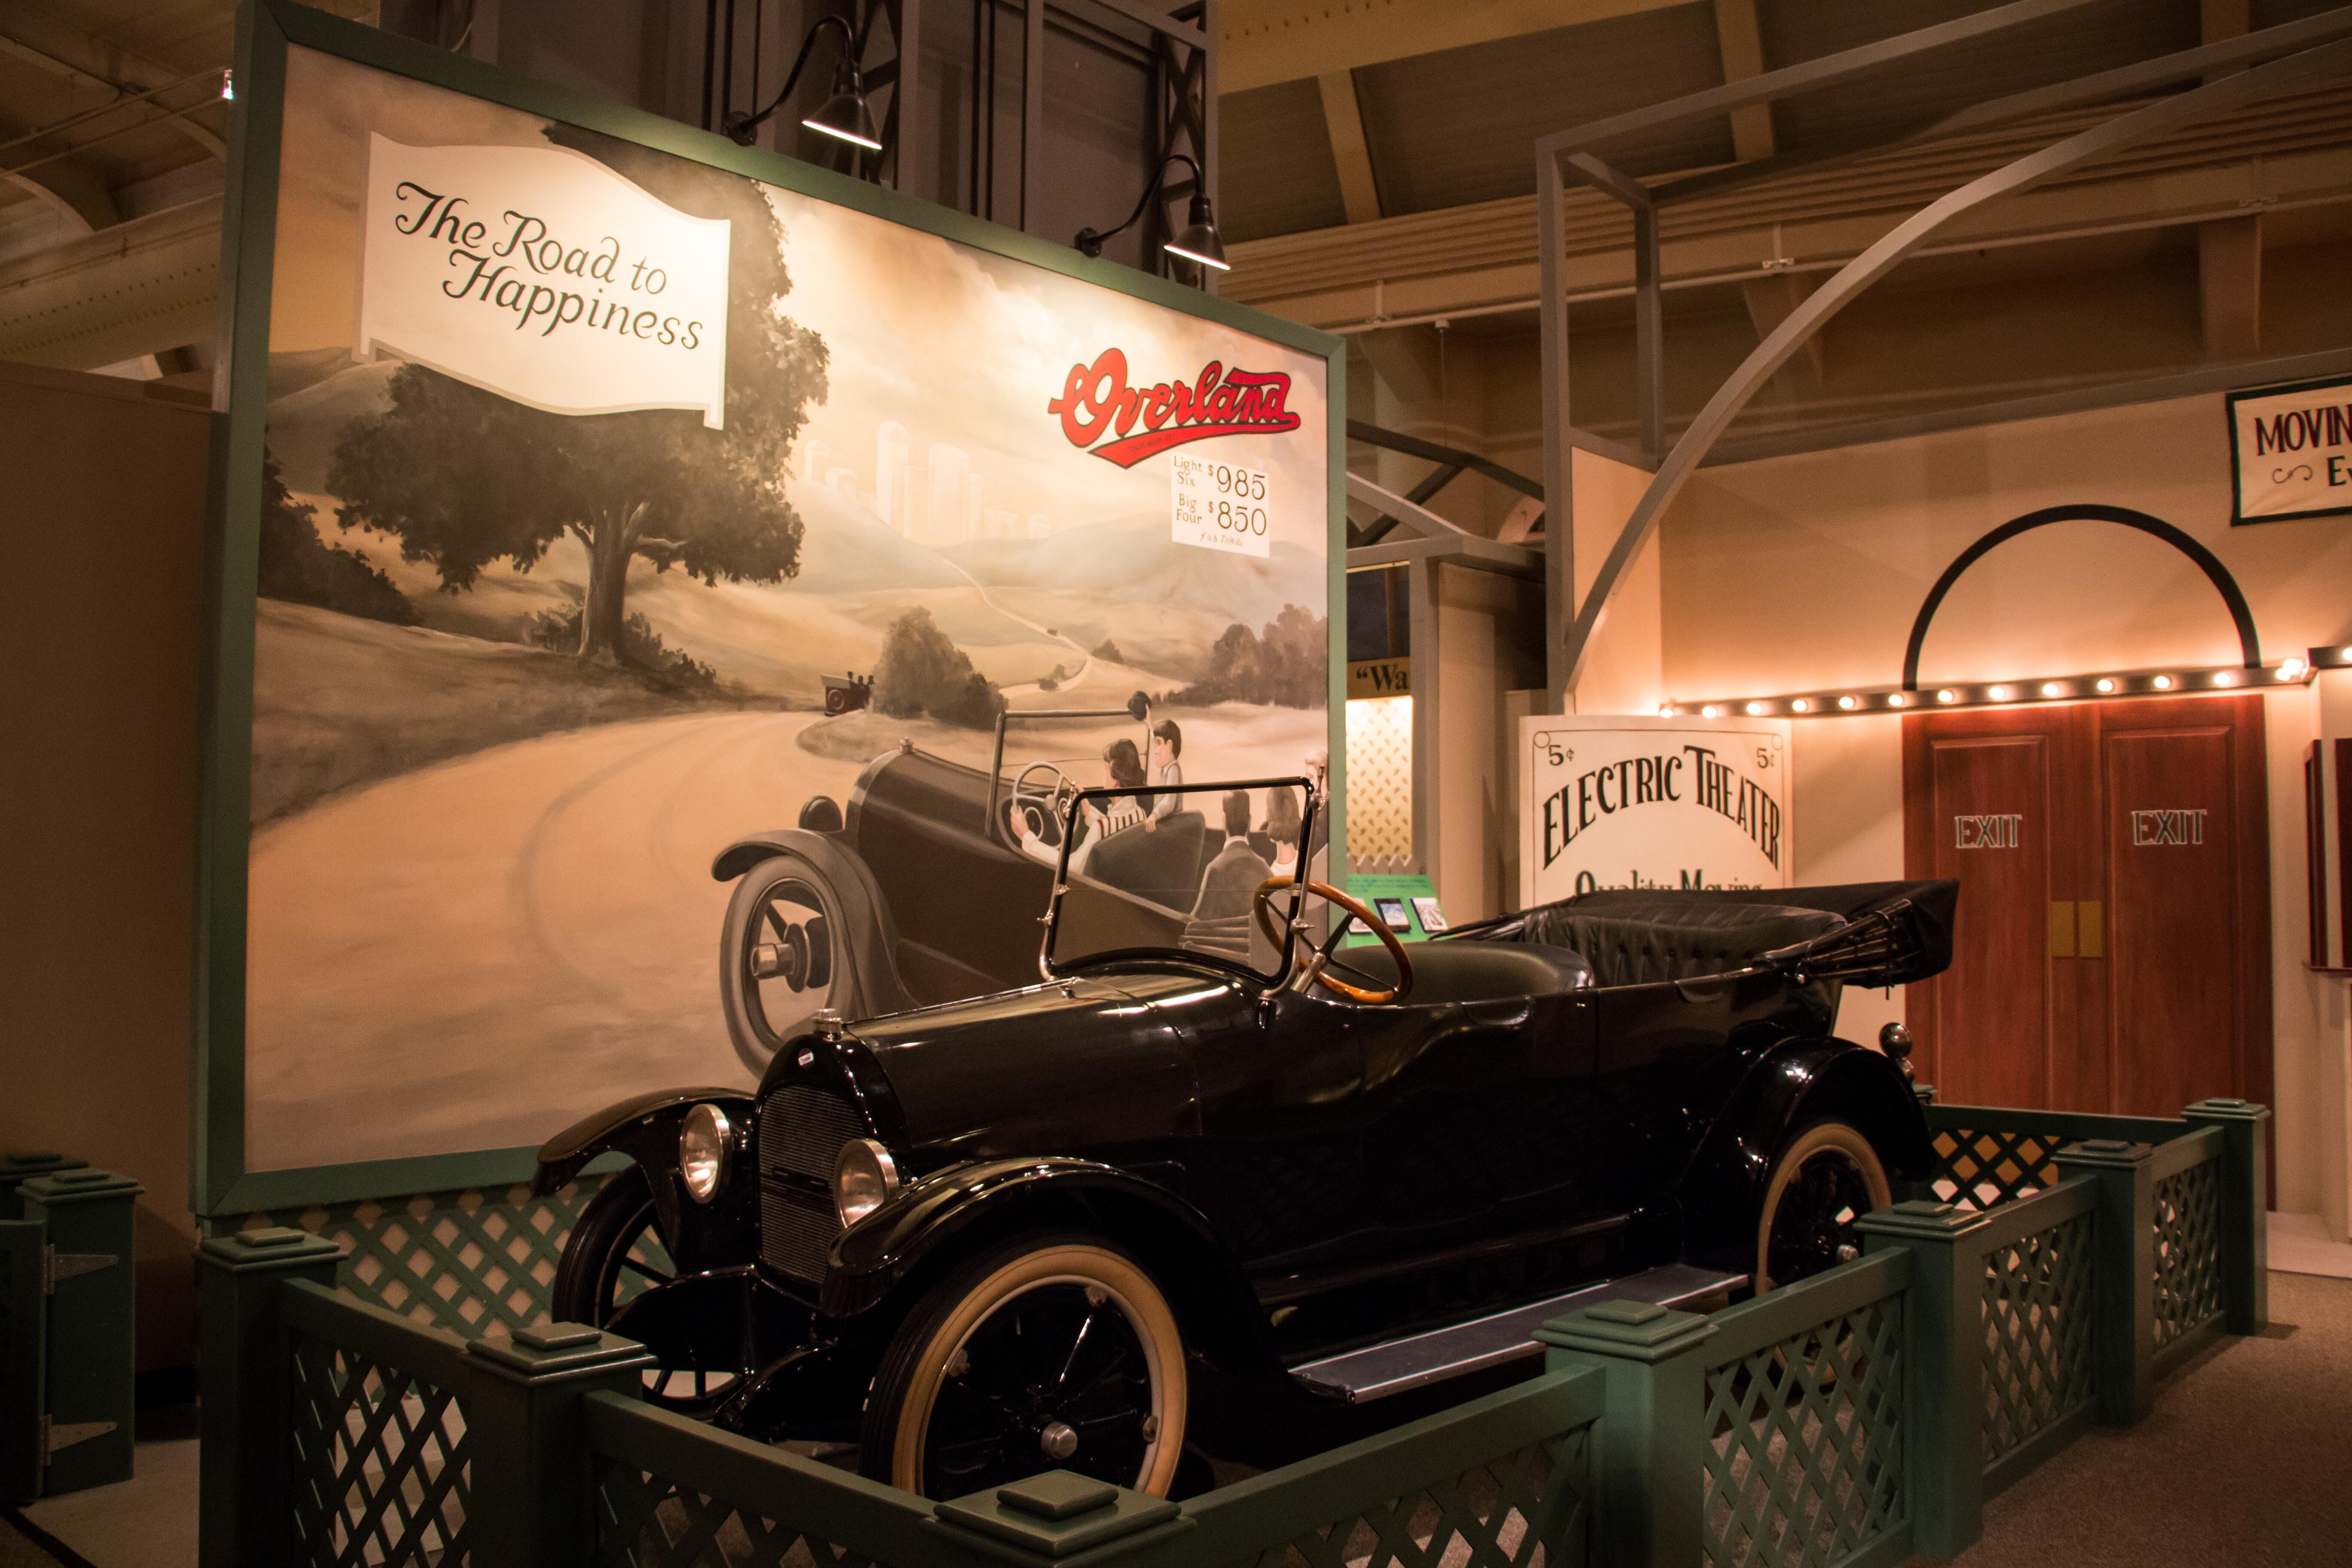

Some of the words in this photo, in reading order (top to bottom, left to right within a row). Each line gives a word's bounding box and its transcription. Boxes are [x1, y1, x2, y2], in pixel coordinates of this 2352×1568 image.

[395, 182, 486, 248] The
[492, 210, 620, 283] Road
[632, 256, 667, 294] to
[442, 248, 703, 349] Happiness
[1048, 347, 1301, 449] Overland
[1173, 455, 1202, 475] Light
[1177, 471, 1195, 487] Six
[1208, 465, 1265, 500] $985
[1176, 508, 1202, 524] Four
[1179, 493, 1197, 513] Big
[1208, 501, 1266, 536] $850
[1549, 745, 1574, 766] 5¢
[1543, 756, 1682, 871] ELECTRIC
[1683, 744, 1780, 871] THEATER
[1954, 814, 2022, 848] EXIT
[2131, 809, 2207, 845] EXIT
